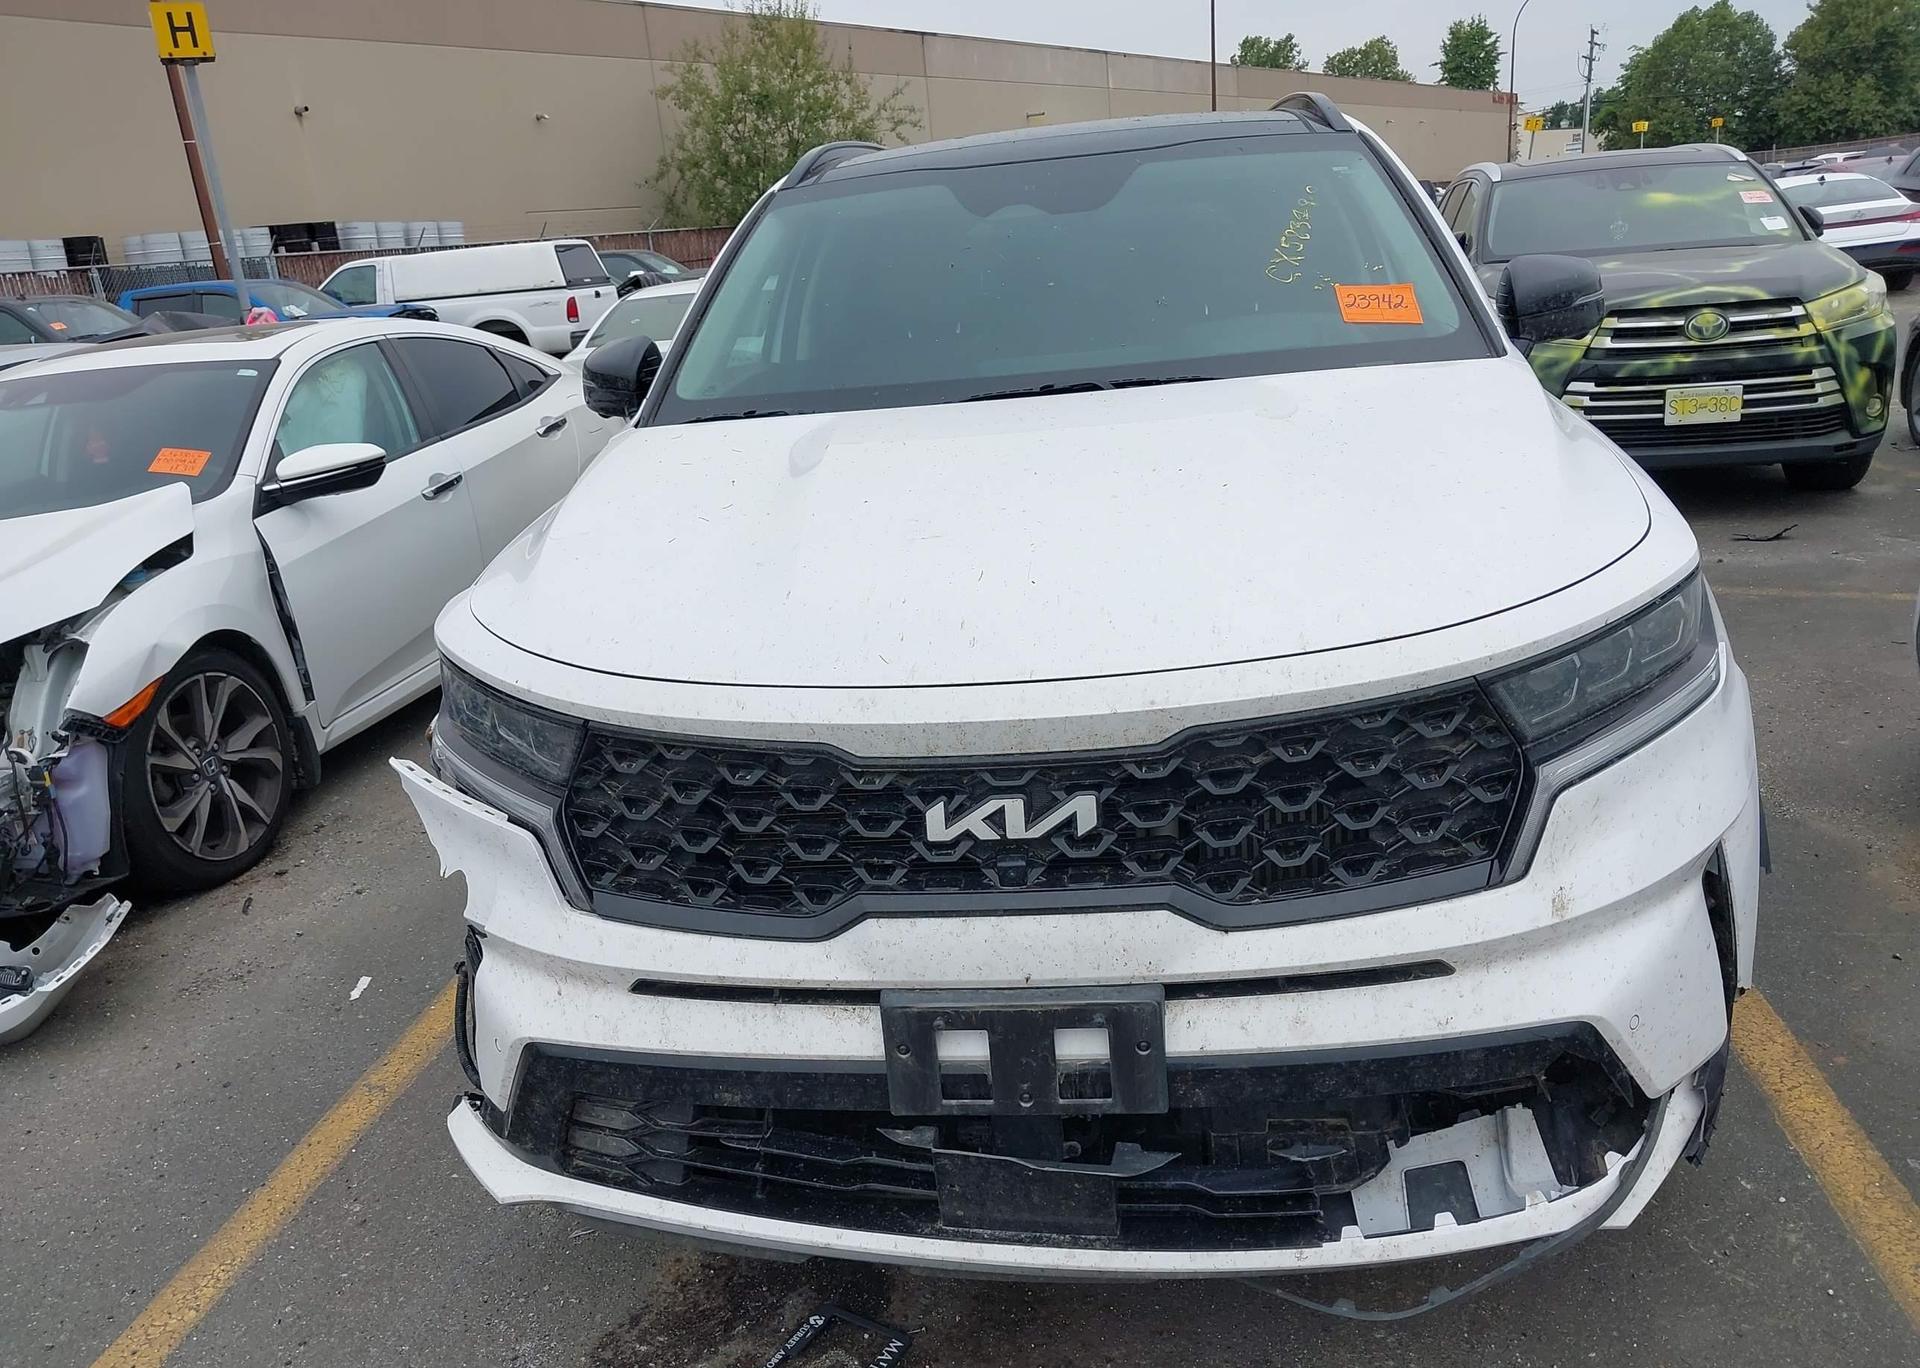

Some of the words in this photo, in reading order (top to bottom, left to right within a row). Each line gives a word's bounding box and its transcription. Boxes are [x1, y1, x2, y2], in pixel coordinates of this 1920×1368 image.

[166, 11, 199, 49] H
[1344, 293, 1409, 310] 23942
[925, 794, 1098, 842] KIA
[785, 1323, 811, 1350] SURREY
[763, 1348, 786, 1368] ABBO
